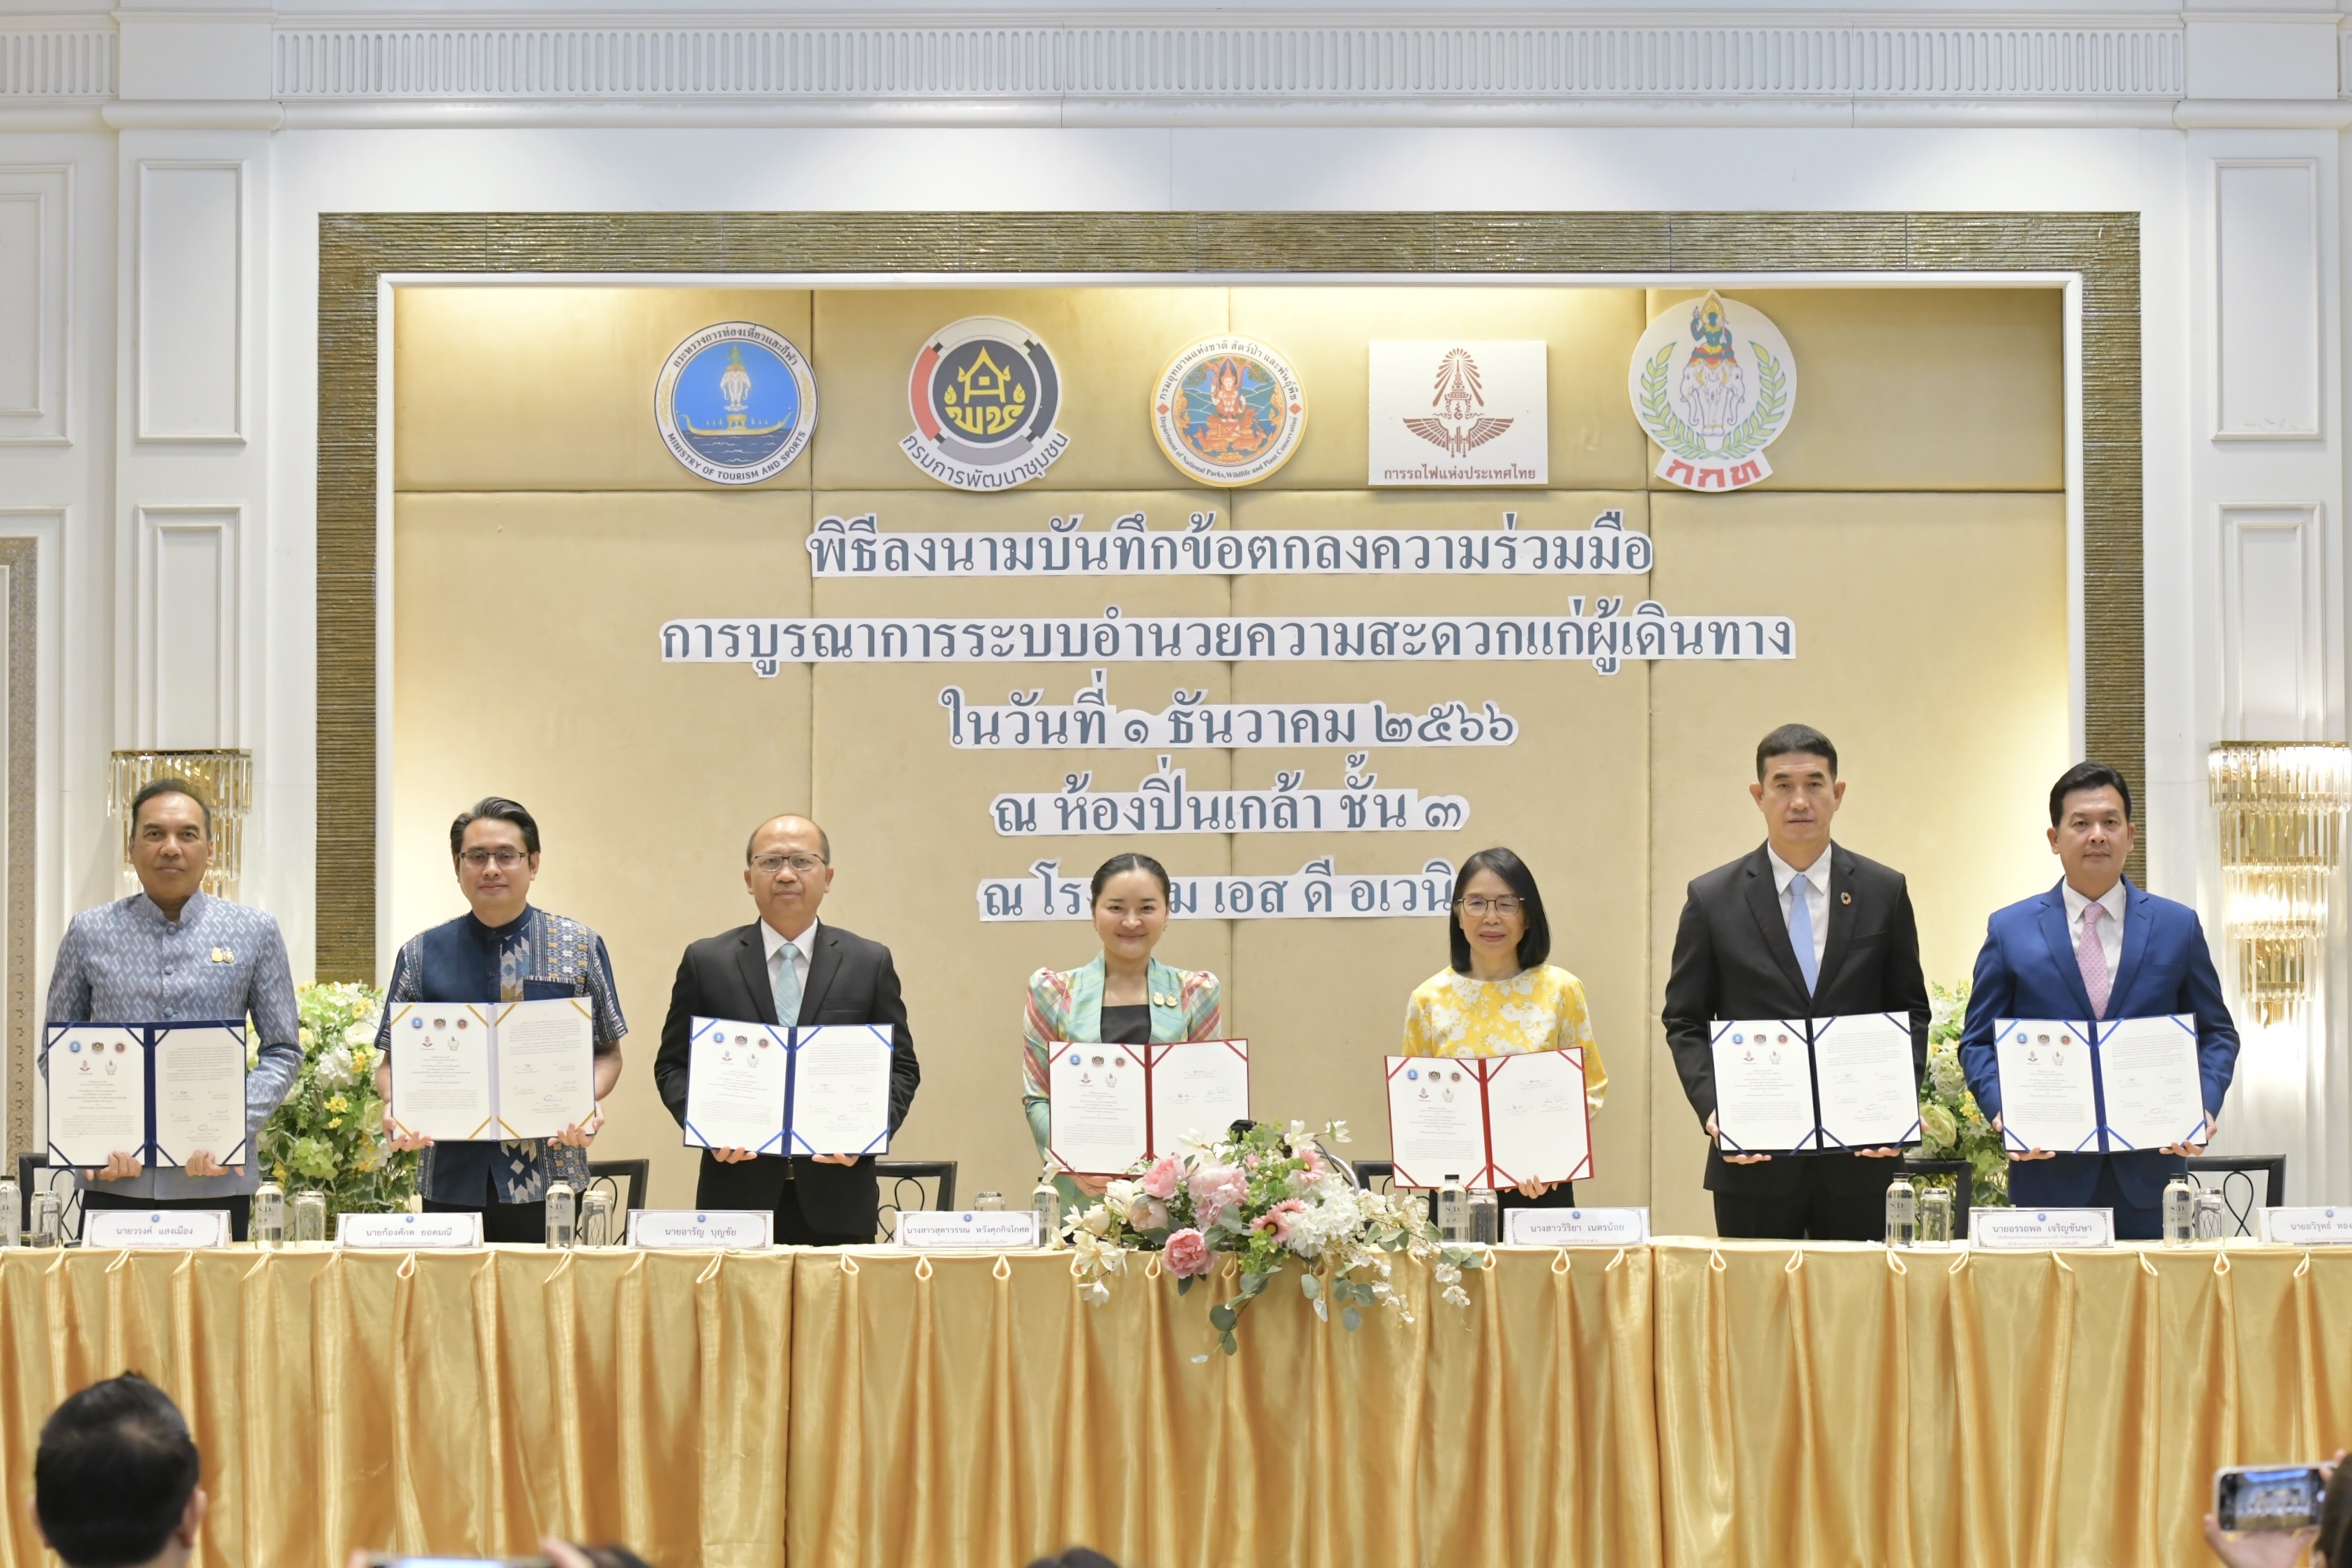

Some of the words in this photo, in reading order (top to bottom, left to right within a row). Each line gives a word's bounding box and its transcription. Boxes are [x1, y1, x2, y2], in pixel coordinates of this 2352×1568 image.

[673, 325, 797, 368] กระทรวงการท่องเที่ยวและกีฬา
[1159, 339, 1228, 400] กรมอุทยานแห่งชาติ
[1231, 339, 1262, 358] สัตว์ป่า
[1264, 354, 1299, 401] และพันธุ์พืช
[667, 433, 701, 469] MINISTRY
[702, 466, 714, 475] OF
[717, 470, 759, 480] TOURISM
[762, 462, 781, 475] AND
[781, 431, 806, 462] SPORTS
[902, 432, 1069, 489] กรมการพัฒนาชุมชน
[1160, 416, 1177, 453] Department
[1176, 450, 1184, 459] of
[1182, 456, 1206, 474] National
[1252, 463, 1264, 473] and
[1263, 454, 1278, 467] Plant
[1276, 416, 1299, 455] Conservation
[1384, 463, 1536, 480] การรถไฟแห่งประเทศไทย
[1665, 459, 1762, 488] กกท
[809, 512, 1651, 572] พิธีลงนามบันทึกข้อตกลงความร่วมมือ
[663, 598, 1790, 675] การบูรณาการระบบอำนวยความสะดวกแก่ผู้เดินทาง
[942, 670, 1106, 745] ในวันที่
[1124, 719, 1149, 744] ๑
[1168, 690, 1355, 744] ธันวาคม
[1375, 702, 1514, 743] ๒๕๖๖
[995, 799, 1037, 831] ณ
[1054, 757, 1321, 831] ห้องปิ่นเกล้า
[1340, 754, 1406, 829] ชั้น
[1425, 802, 1461, 828] ๓
[984, 883, 1023, 916] ณ
[1215, 880, 1288, 914] เอส
[1304, 859, 1332, 912] ดี
[1350, 861, 1452, 912] อเวนิ
[421, 1227, 452, 1236] ยอดมณี
[665, 1227, 704, 1238] นายอารัญ
[711, 1227, 736, 1238] บุญชัย
[907, 1226, 970, 1236] นางสาวสุดาวรรณ
[976, 1224, 1030, 1236] หวังศุภกิจโกศล
[1588, 1222, 1624, 1232] เนตรน้อย
